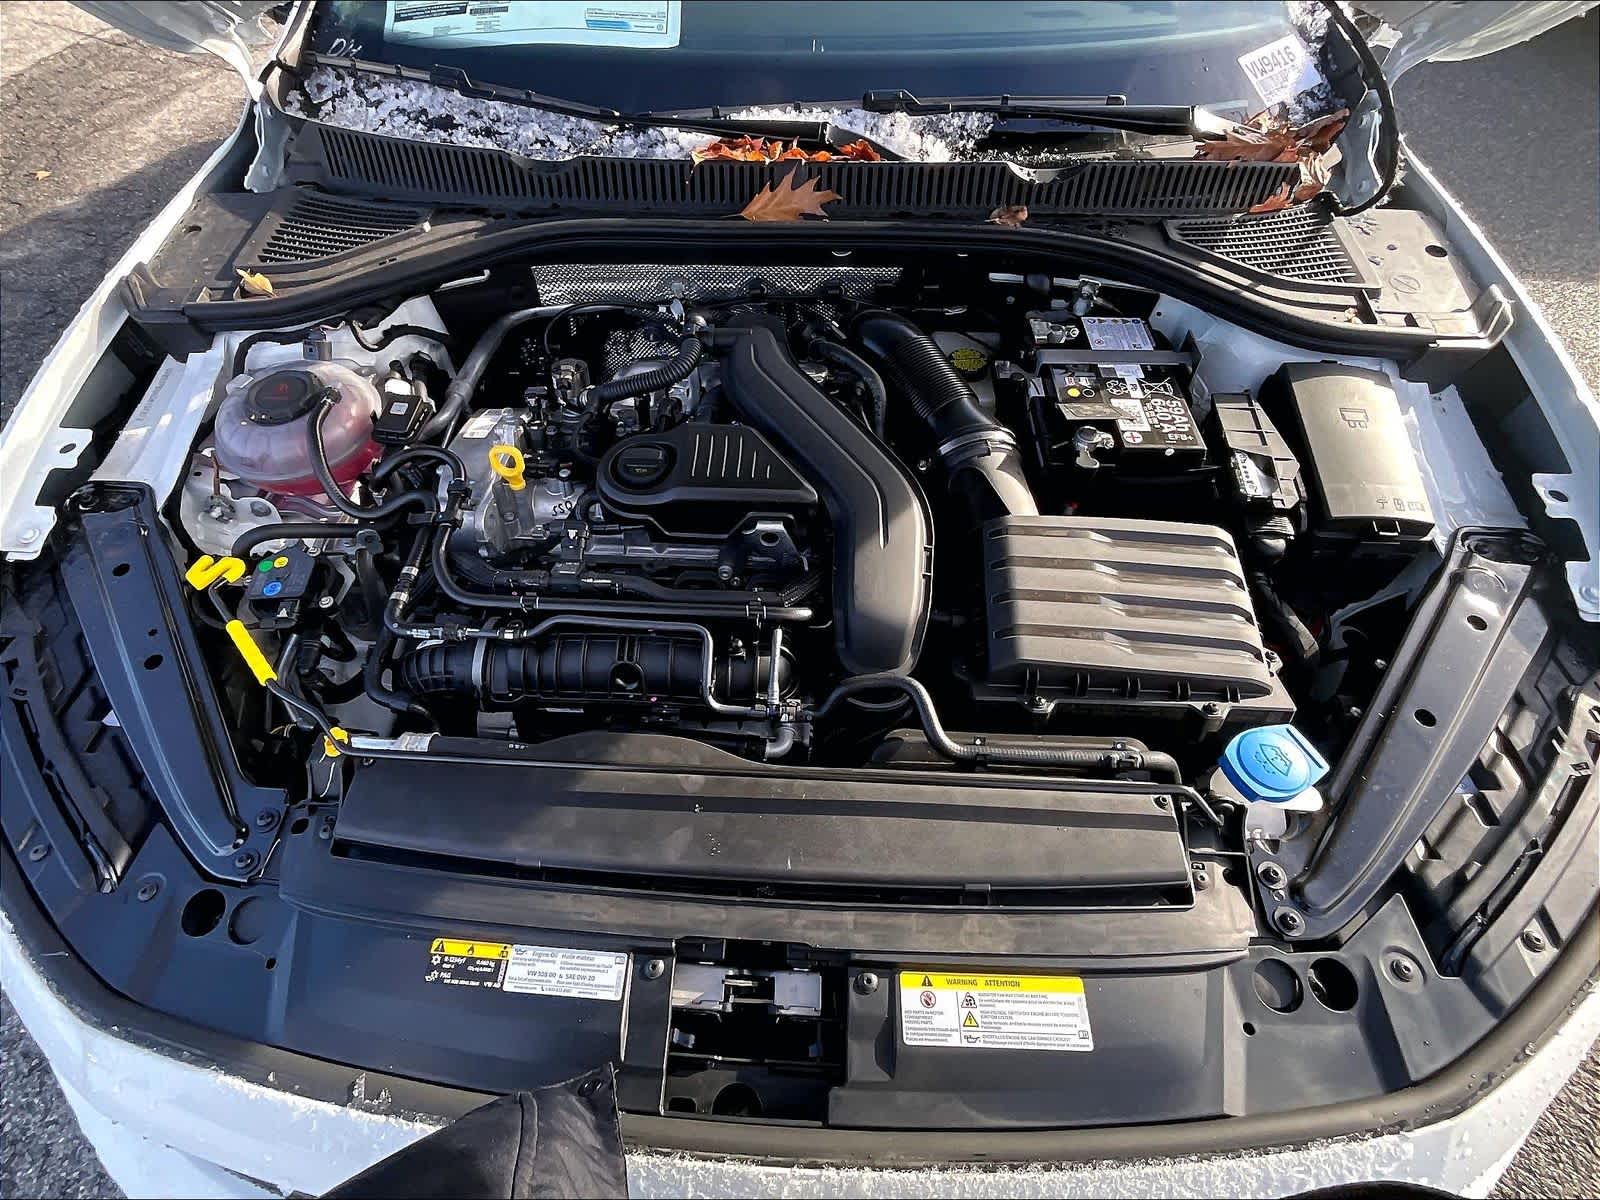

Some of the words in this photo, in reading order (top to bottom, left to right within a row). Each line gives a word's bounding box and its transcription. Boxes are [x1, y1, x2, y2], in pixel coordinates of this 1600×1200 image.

[1245, 45, 1297, 79] VW9416
[1151, 399, 1172, 421] 640
[1166, 400, 1192, 432] 59Ah
[945, 977, 978, 986] WARNING
[984, 979, 1020, 987] ATTENTION
